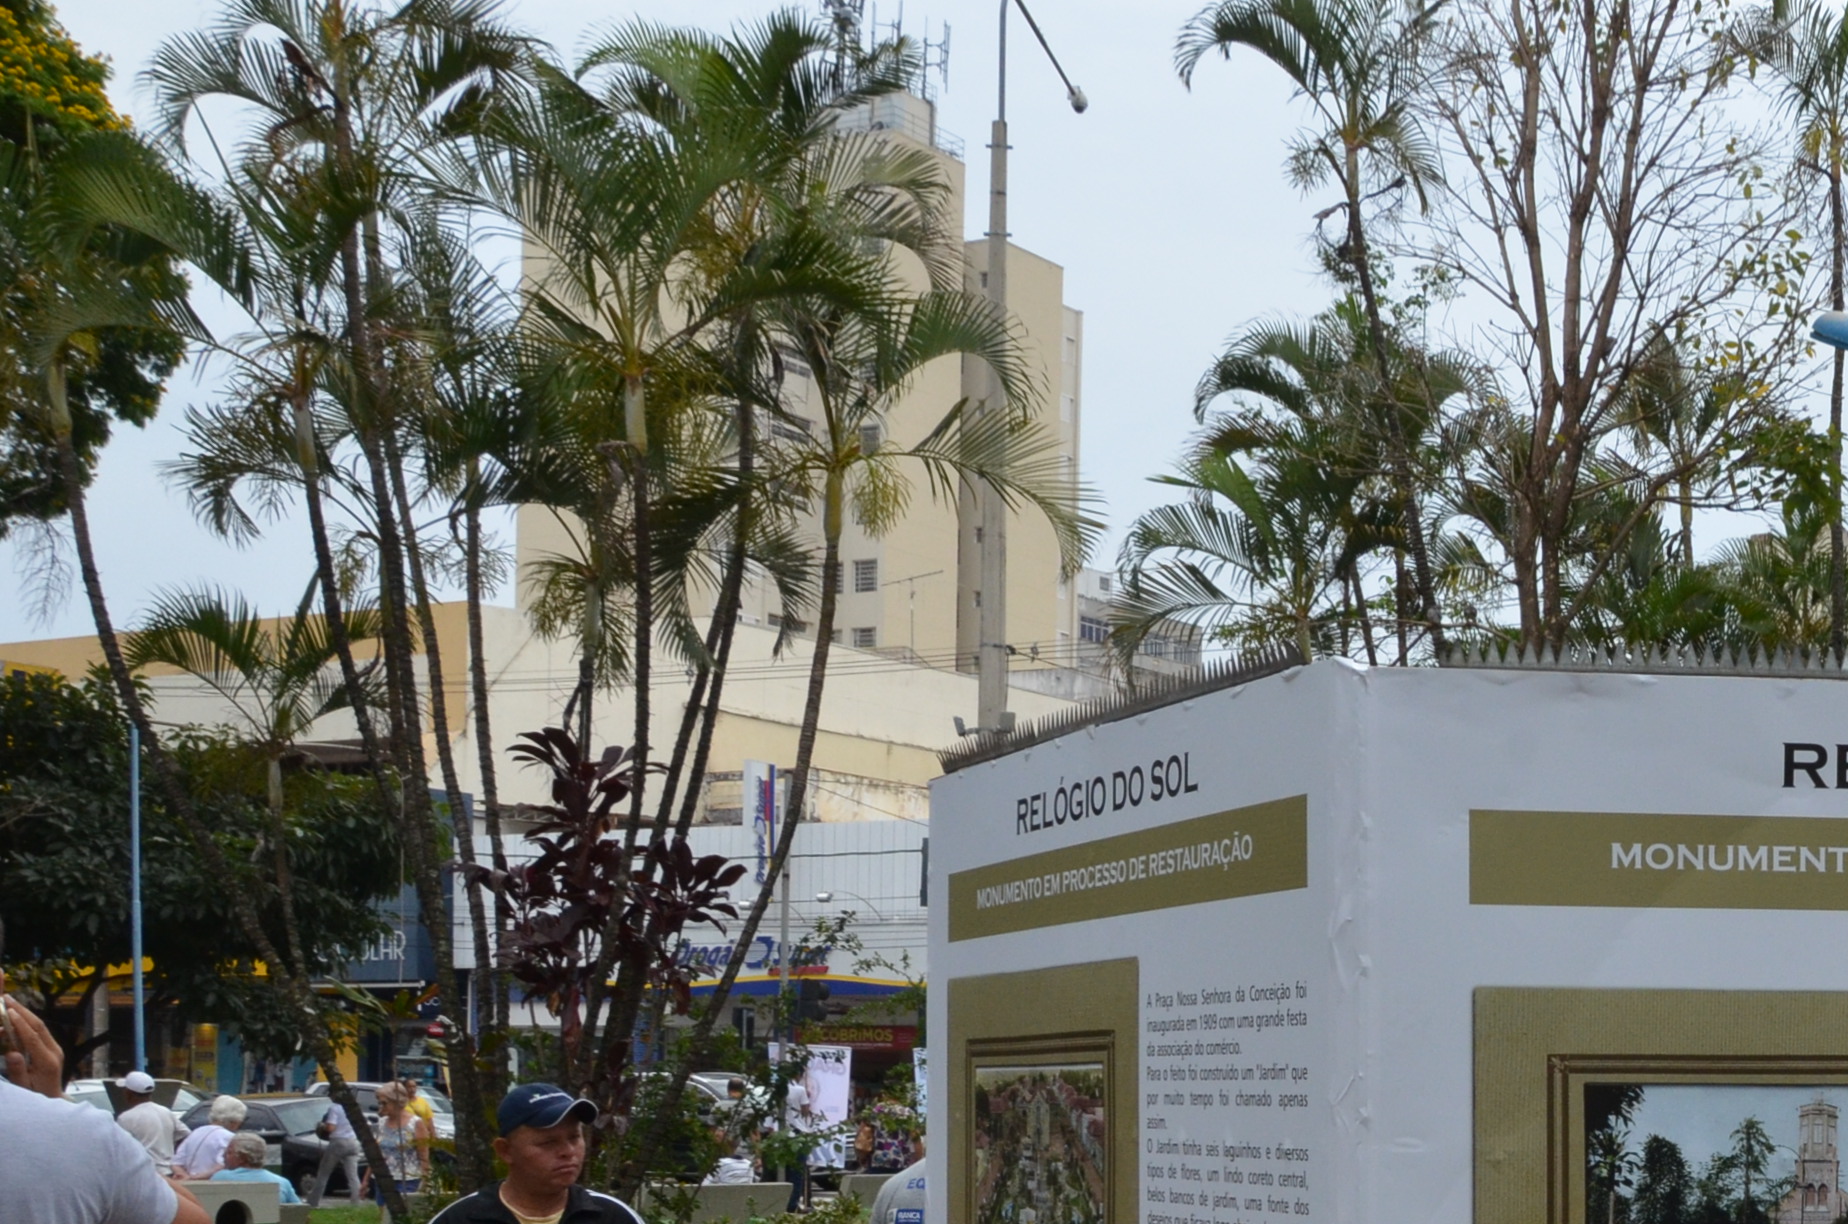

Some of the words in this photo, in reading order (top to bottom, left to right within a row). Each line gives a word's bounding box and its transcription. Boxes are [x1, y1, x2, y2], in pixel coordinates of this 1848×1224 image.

[1017, 777, 1105, 835] RELÓGIO
[1113, 765, 1143, 811] DO
[1150, 752, 1198, 801] SOL
[977, 874, 1041, 909] MONUMENTO
[1044, 871, 1060, 896] EM
[1062, 862, 1126, 894] PROCESSO
[1129, 857, 1147, 880] DE
[1149, 831, 1252, 877] RESTAURAÇÃO
[1147, 994, 1151, 1008] A
[1156, 992, 1173, 1011] Praça
[1177, 992, 1197, 1006] Nossa
[1202, 988, 1231, 1005] Senhora
[1236, 985, 1245, 1001] da
[1250, 983, 1290, 1005] Conceição
[1296, 981, 1307, 999] foi
[1147, 1016, 1184, 1036] inaugurada
[1186, 1019, 1197, 1030] em
[1200, 1014, 1217, 1030] 1909
[1219, 1016, 1234, 1029] com
[1237, 1016, 1254, 1028] uma
[1256, 1011, 1284, 1032] grande
[1287, 1009, 1307, 1026] festa
